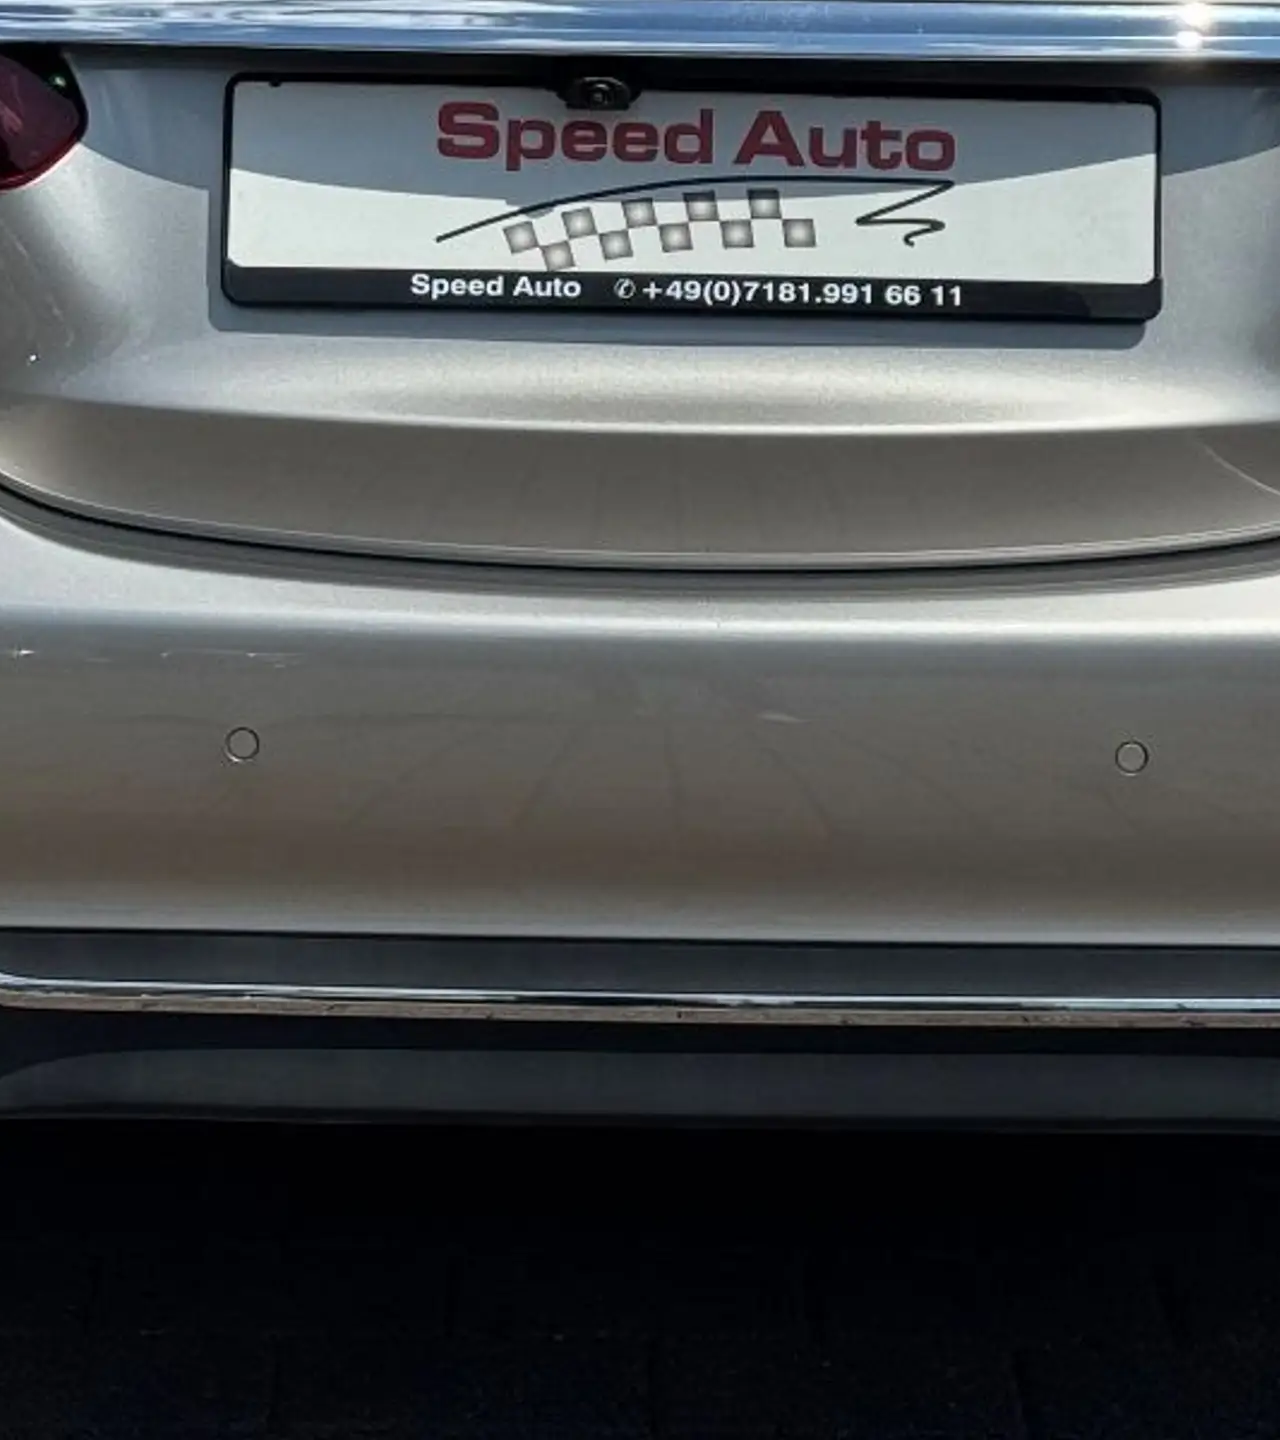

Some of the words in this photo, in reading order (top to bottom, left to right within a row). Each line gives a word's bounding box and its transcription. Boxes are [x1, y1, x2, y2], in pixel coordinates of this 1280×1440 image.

[436, 101, 715, 172] Speed
[732, 109, 957, 172] Auto
[410, 273, 504, 300] Speed
[512, 275, 583, 299] Auto
[642, 279, 872, 307] +49(0)7181.991
[883, 284, 922, 307] 66
[932, 285, 962, 307] 11
